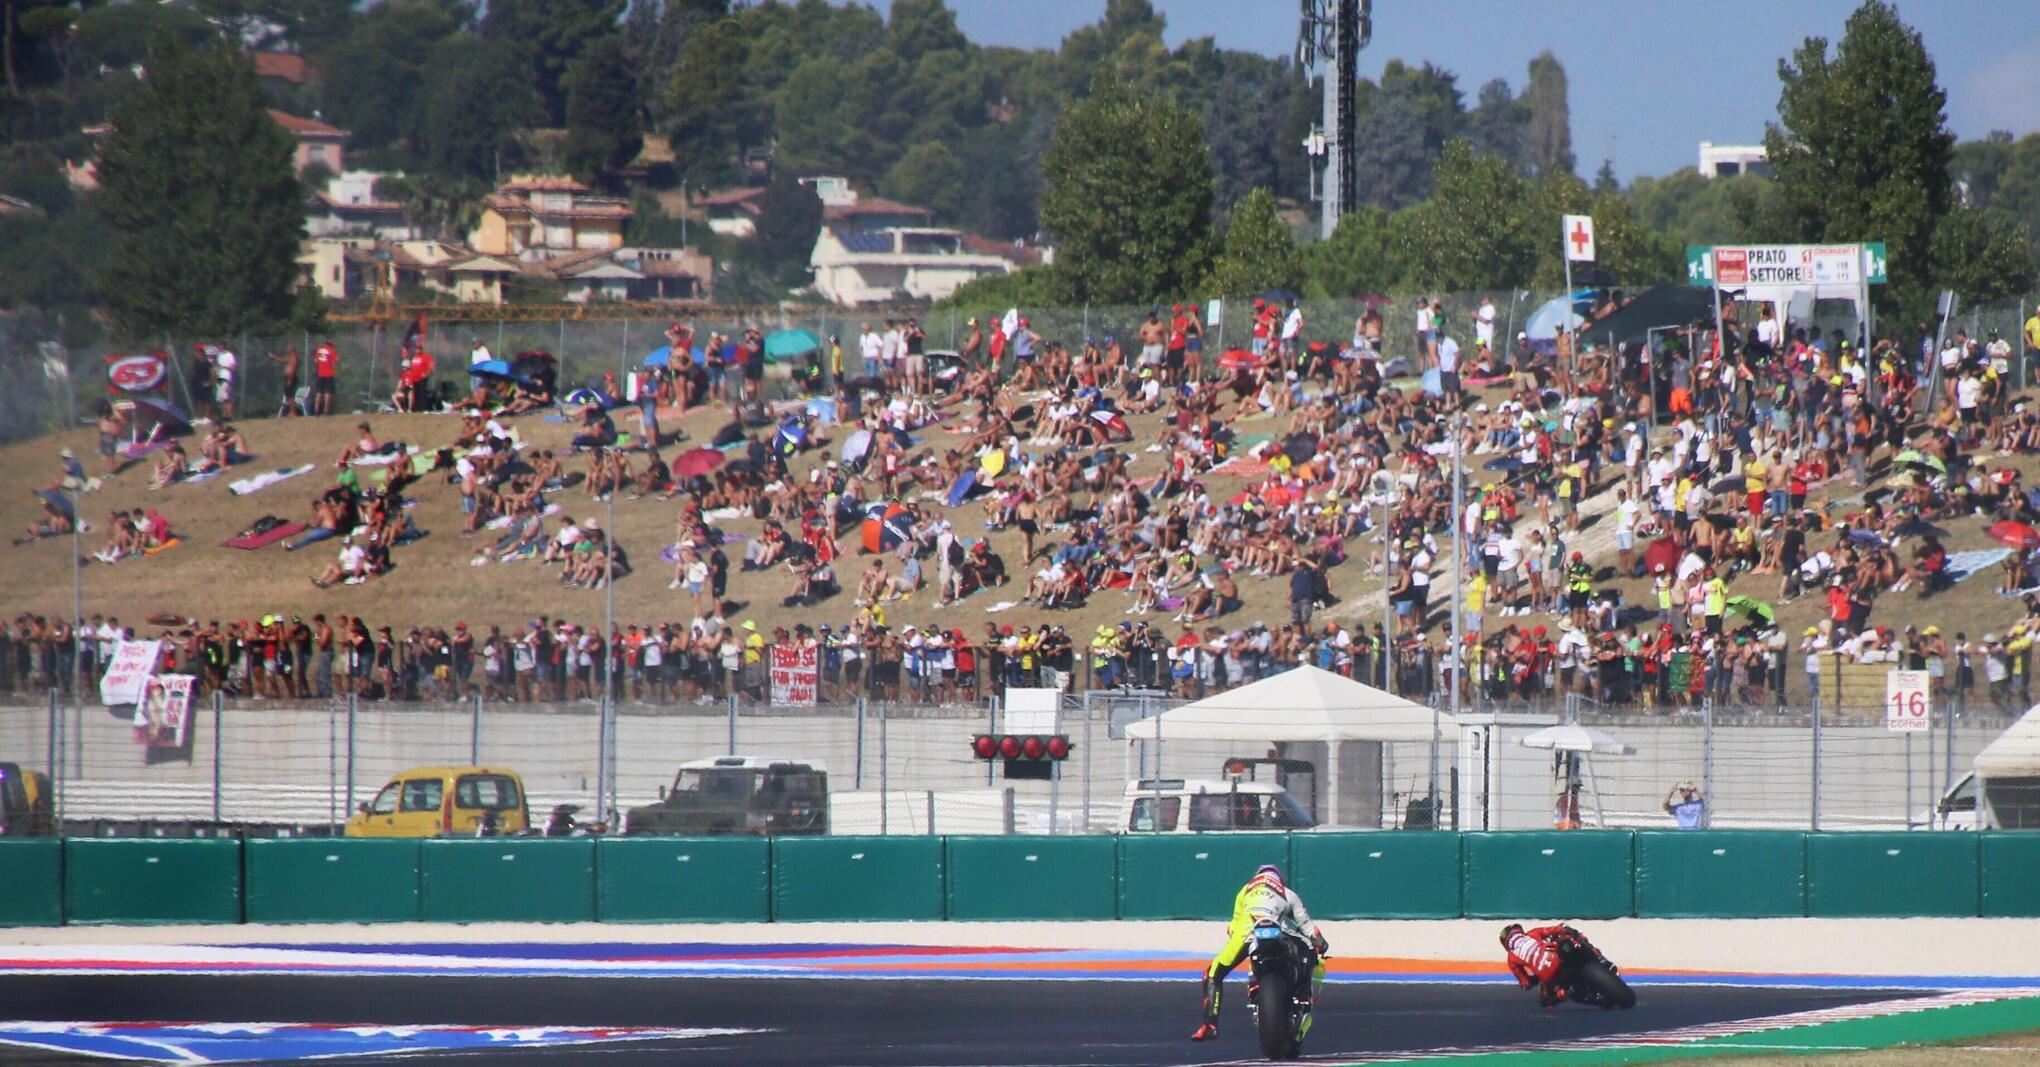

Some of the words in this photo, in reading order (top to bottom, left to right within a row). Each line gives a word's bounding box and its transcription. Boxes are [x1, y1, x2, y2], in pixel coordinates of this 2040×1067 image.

[1749, 250, 1786, 264] PRATO
[1750, 267, 1801, 282] SETTORE
[1892, 691, 1925, 717] 16
[1890, 720, 1927, 728] corner
